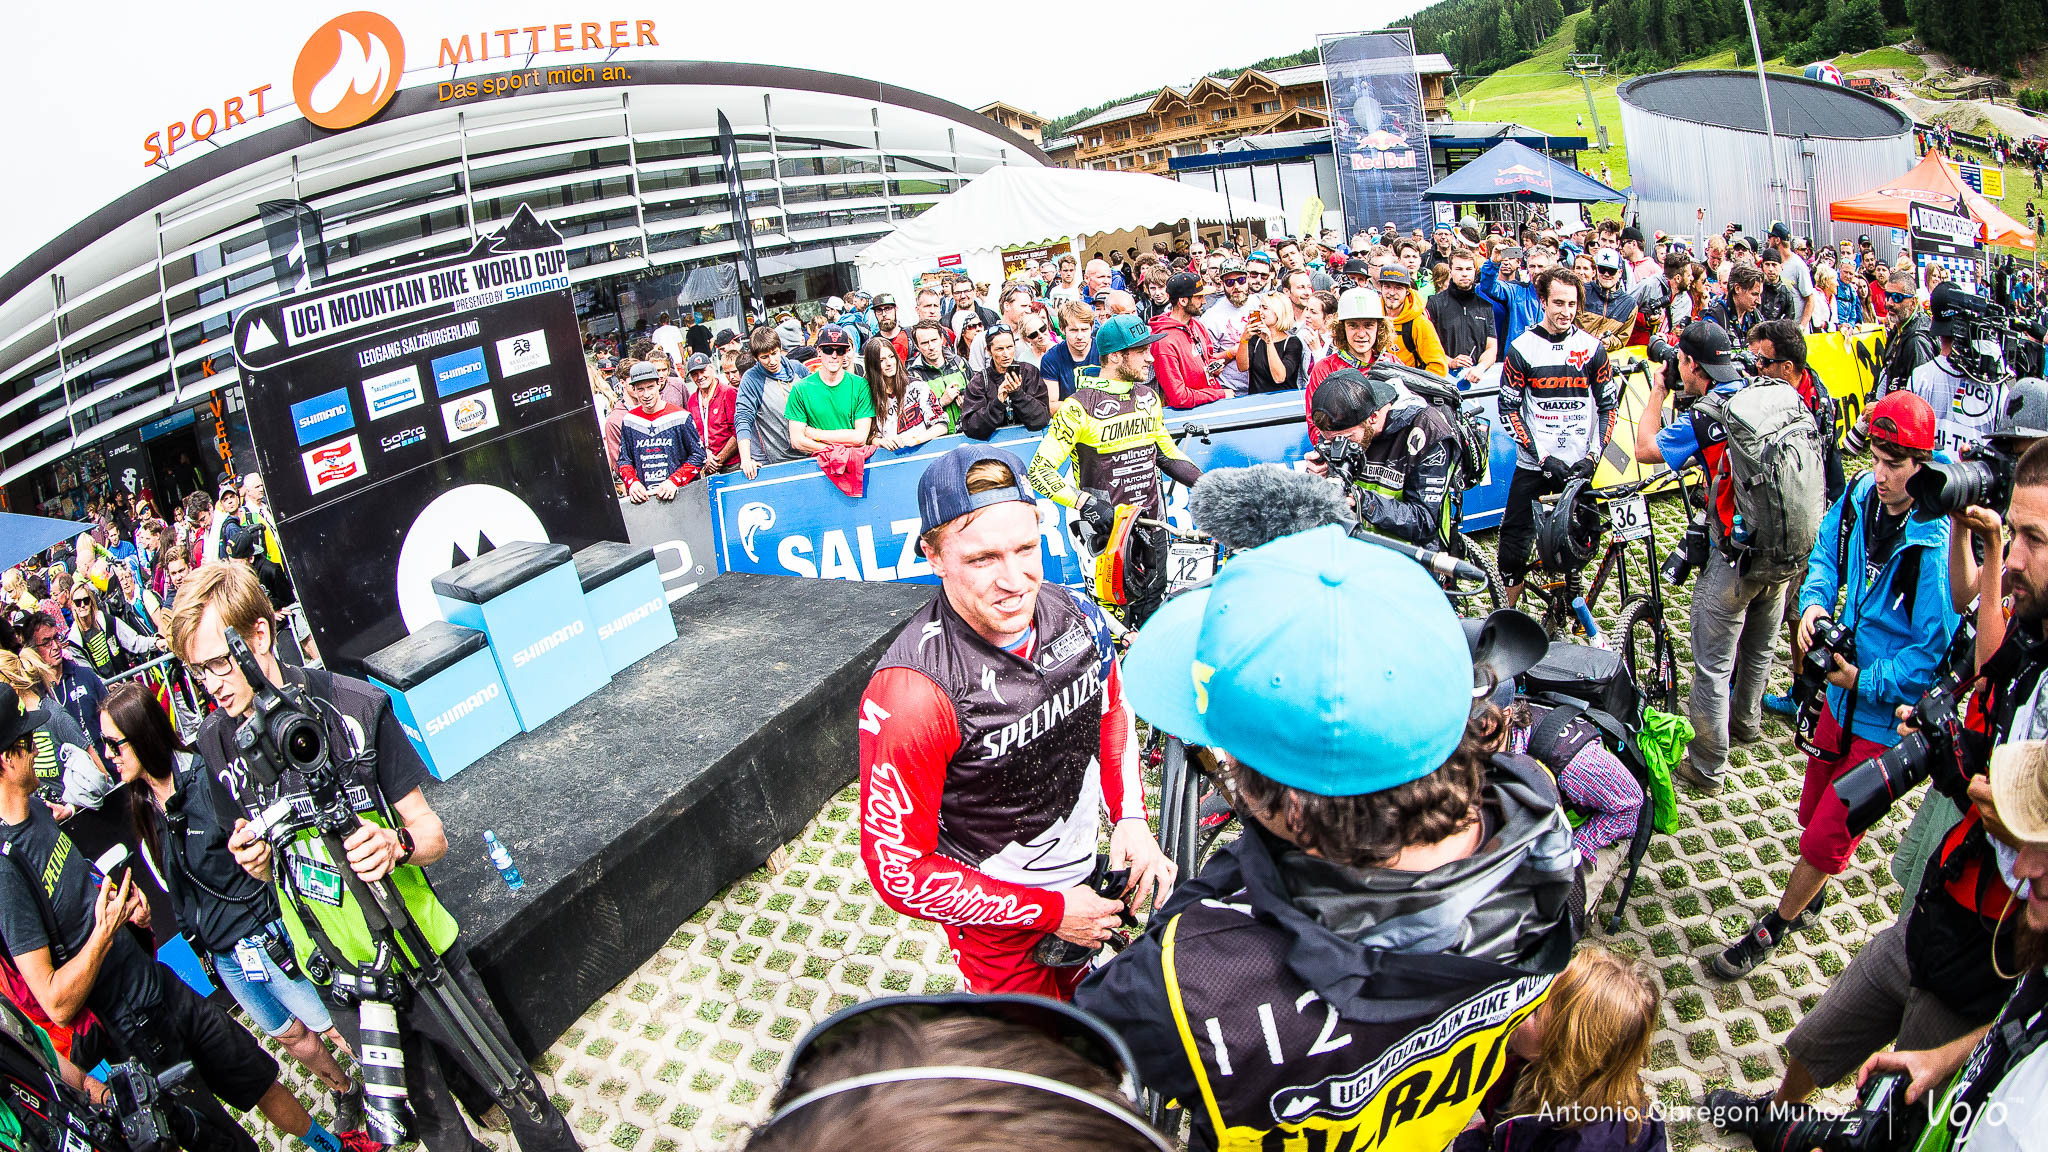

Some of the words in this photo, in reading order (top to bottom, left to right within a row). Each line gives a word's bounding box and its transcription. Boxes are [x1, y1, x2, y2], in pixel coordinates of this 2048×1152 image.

[144, 84, 272, 168] SPORT
[438, 20, 659, 68] MITTERER
[438, 82, 478, 102] Das
[482, 69, 540, 95] sport
[548, 65, 595, 84] mich
[602, 66, 632, 82] an.
[1351, 151, 1384, 170] Red
[1384, 150, 1416, 169] Bull
[291, 301, 325, 338] UCI
[329, 281, 425, 329] MOUNTAIN
[428, 268, 468, 301] BIKE
[473, 258, 533, 289] WORLD
[534, 249, 566, 276] CUP
[456, 291, 494, 311] PRESENTED
[494, 290, 504, 304] BY
[506, 276, 569, 299] SHIMANO
[358, 344, 401, 368] LEOGANG
[401, 320, 480, 355] SALZBURGERLAND
[439, 361, 482, 382] SHIMANO
[511, 384, 552, 402] GoPro
[1543, 401, 1579, 410] MAXXIS
[298, 404, 347, 429] SHIMANO
[380, 425, 426, 447] GoPro
[1616, 505, 1637, 529] 36
[1178, 556, 1198, 581] 12
[598, 597, 664, 641] SHIMANO
[511, 619, 585, 669] SHIMANO
[425, 682, 500, 737] SHIMANO
[980, 659, 1102, 761] SPECIALIZE
[1801, 742, 1821, 757] Canon
[1205, 989, 1353, 1076] 112
[1340, 1073, 1373, 1104] UCI
[1378, 1008, 1465, 1080] MOUNTAIN
[1467, 990, 1510, 1021] BIKE
[10, 1083, 40, 1110] EOS
